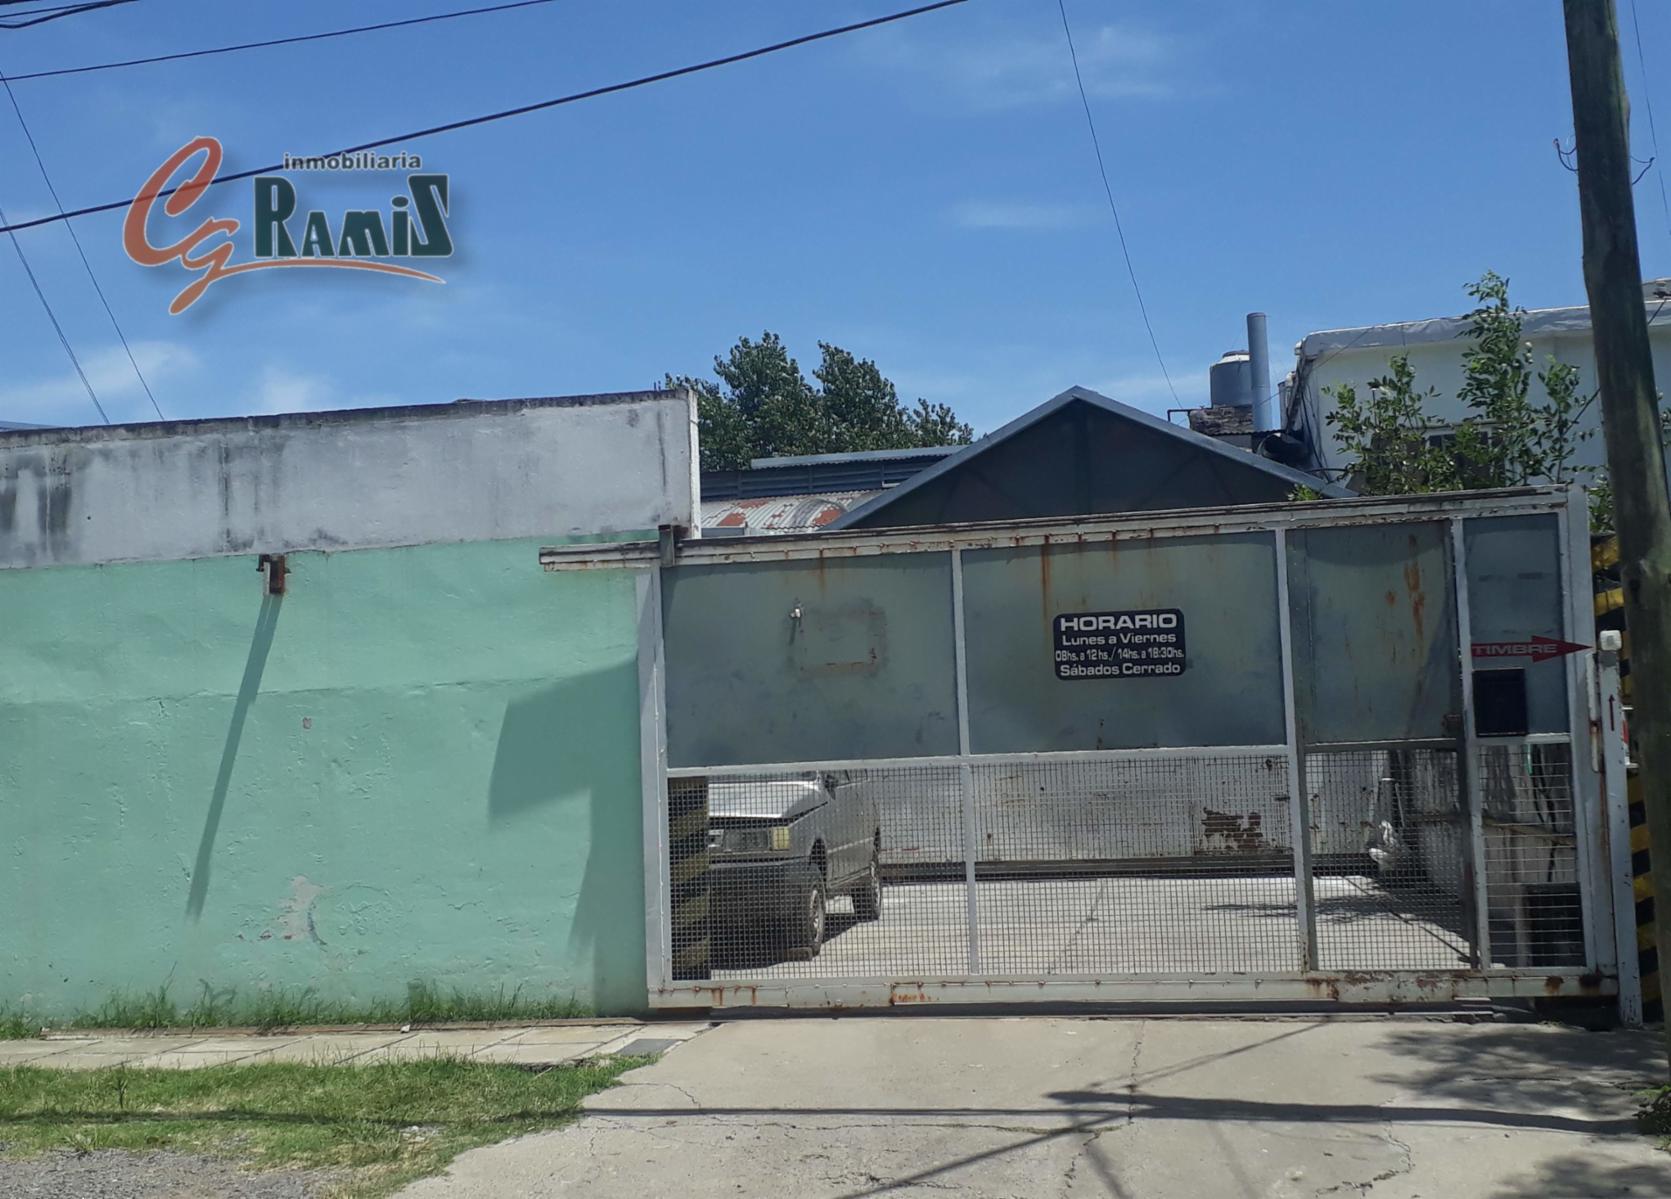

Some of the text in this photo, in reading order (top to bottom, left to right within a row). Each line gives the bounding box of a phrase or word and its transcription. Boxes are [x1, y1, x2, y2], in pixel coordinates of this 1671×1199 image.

[1060, 613, 1177, 631] HORARIO
[1062, 633, 1177, 646] Lunes a Viernes
[1472, 644, 1558, 655] TIMBRE
[1060, 662, 1181, 676] Sábados Cerrado
